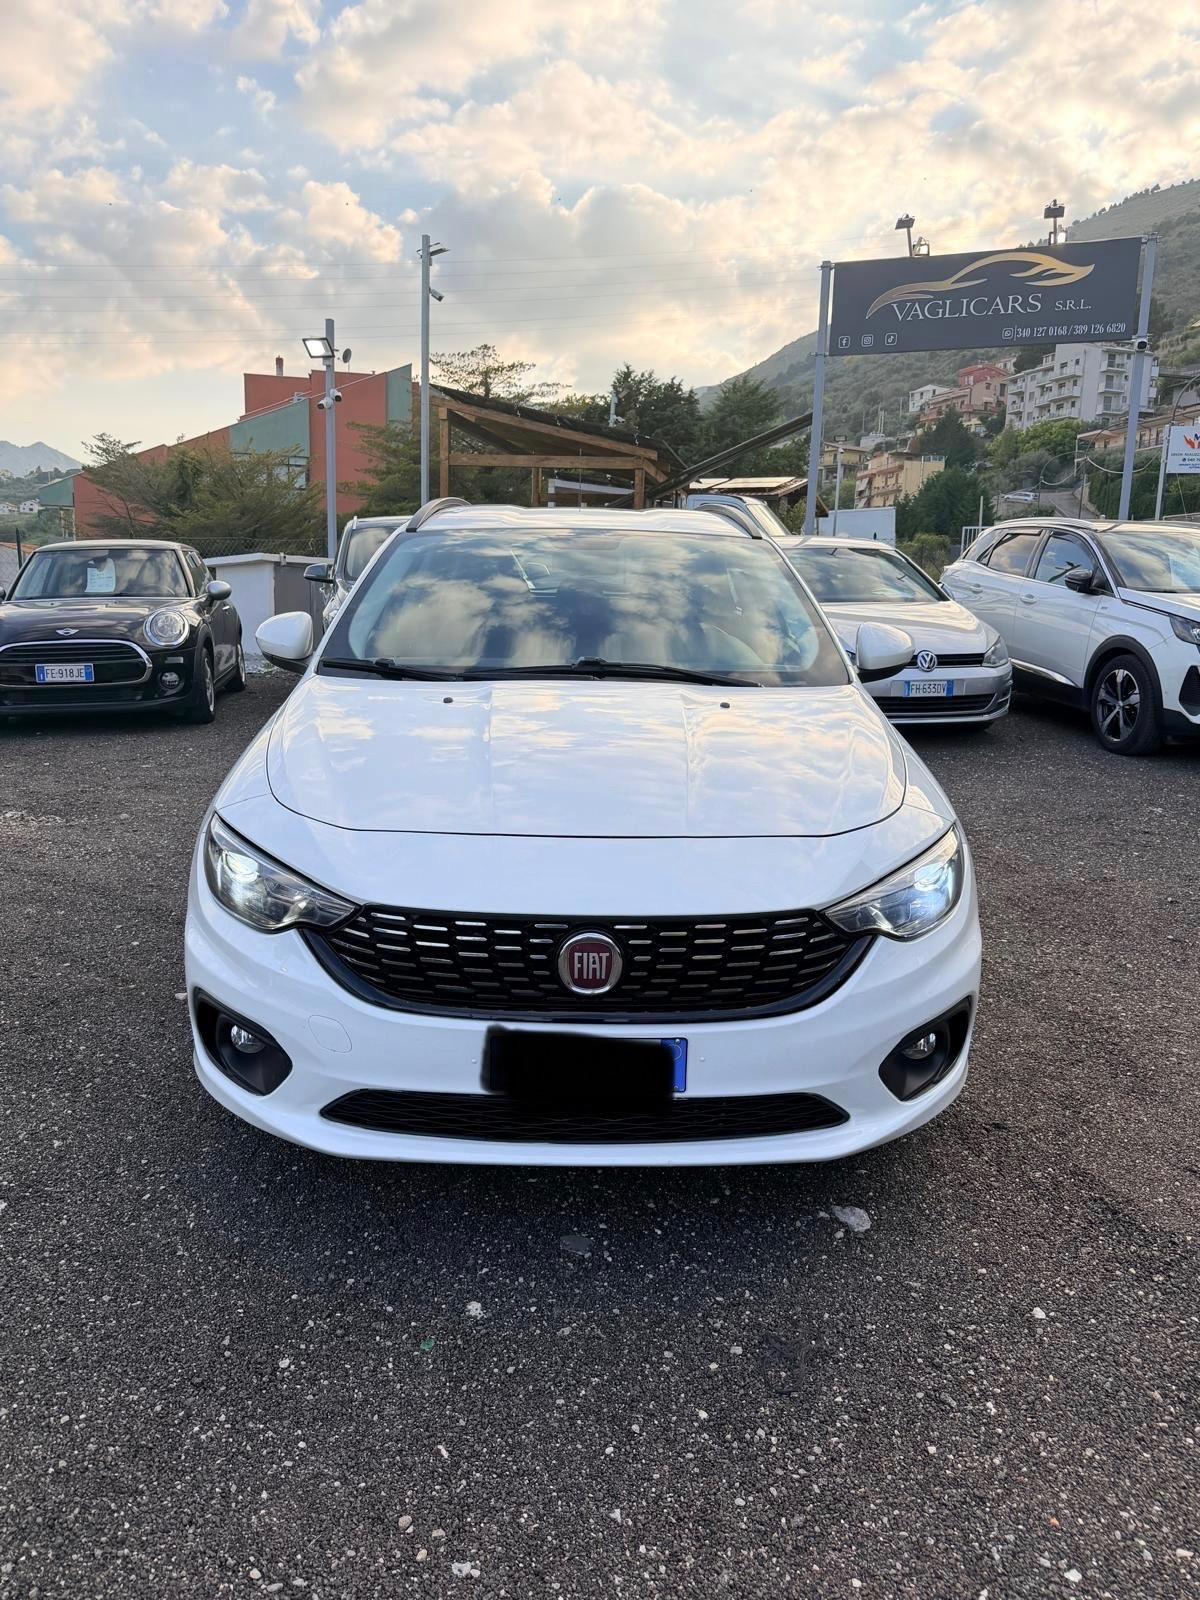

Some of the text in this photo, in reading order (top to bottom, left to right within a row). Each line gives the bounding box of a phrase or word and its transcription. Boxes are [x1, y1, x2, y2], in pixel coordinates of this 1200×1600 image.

[891, 293, 1092, 322] VAGLICARS S.R.L.
[1016, 327, 1031, 338] 340
[1033, 326, 1047, 337] 127
[1090, 323, 1104, 334] 126
[1106, 322, 1126, 333] 6820
[573, 952, 610, 980] FIAT
